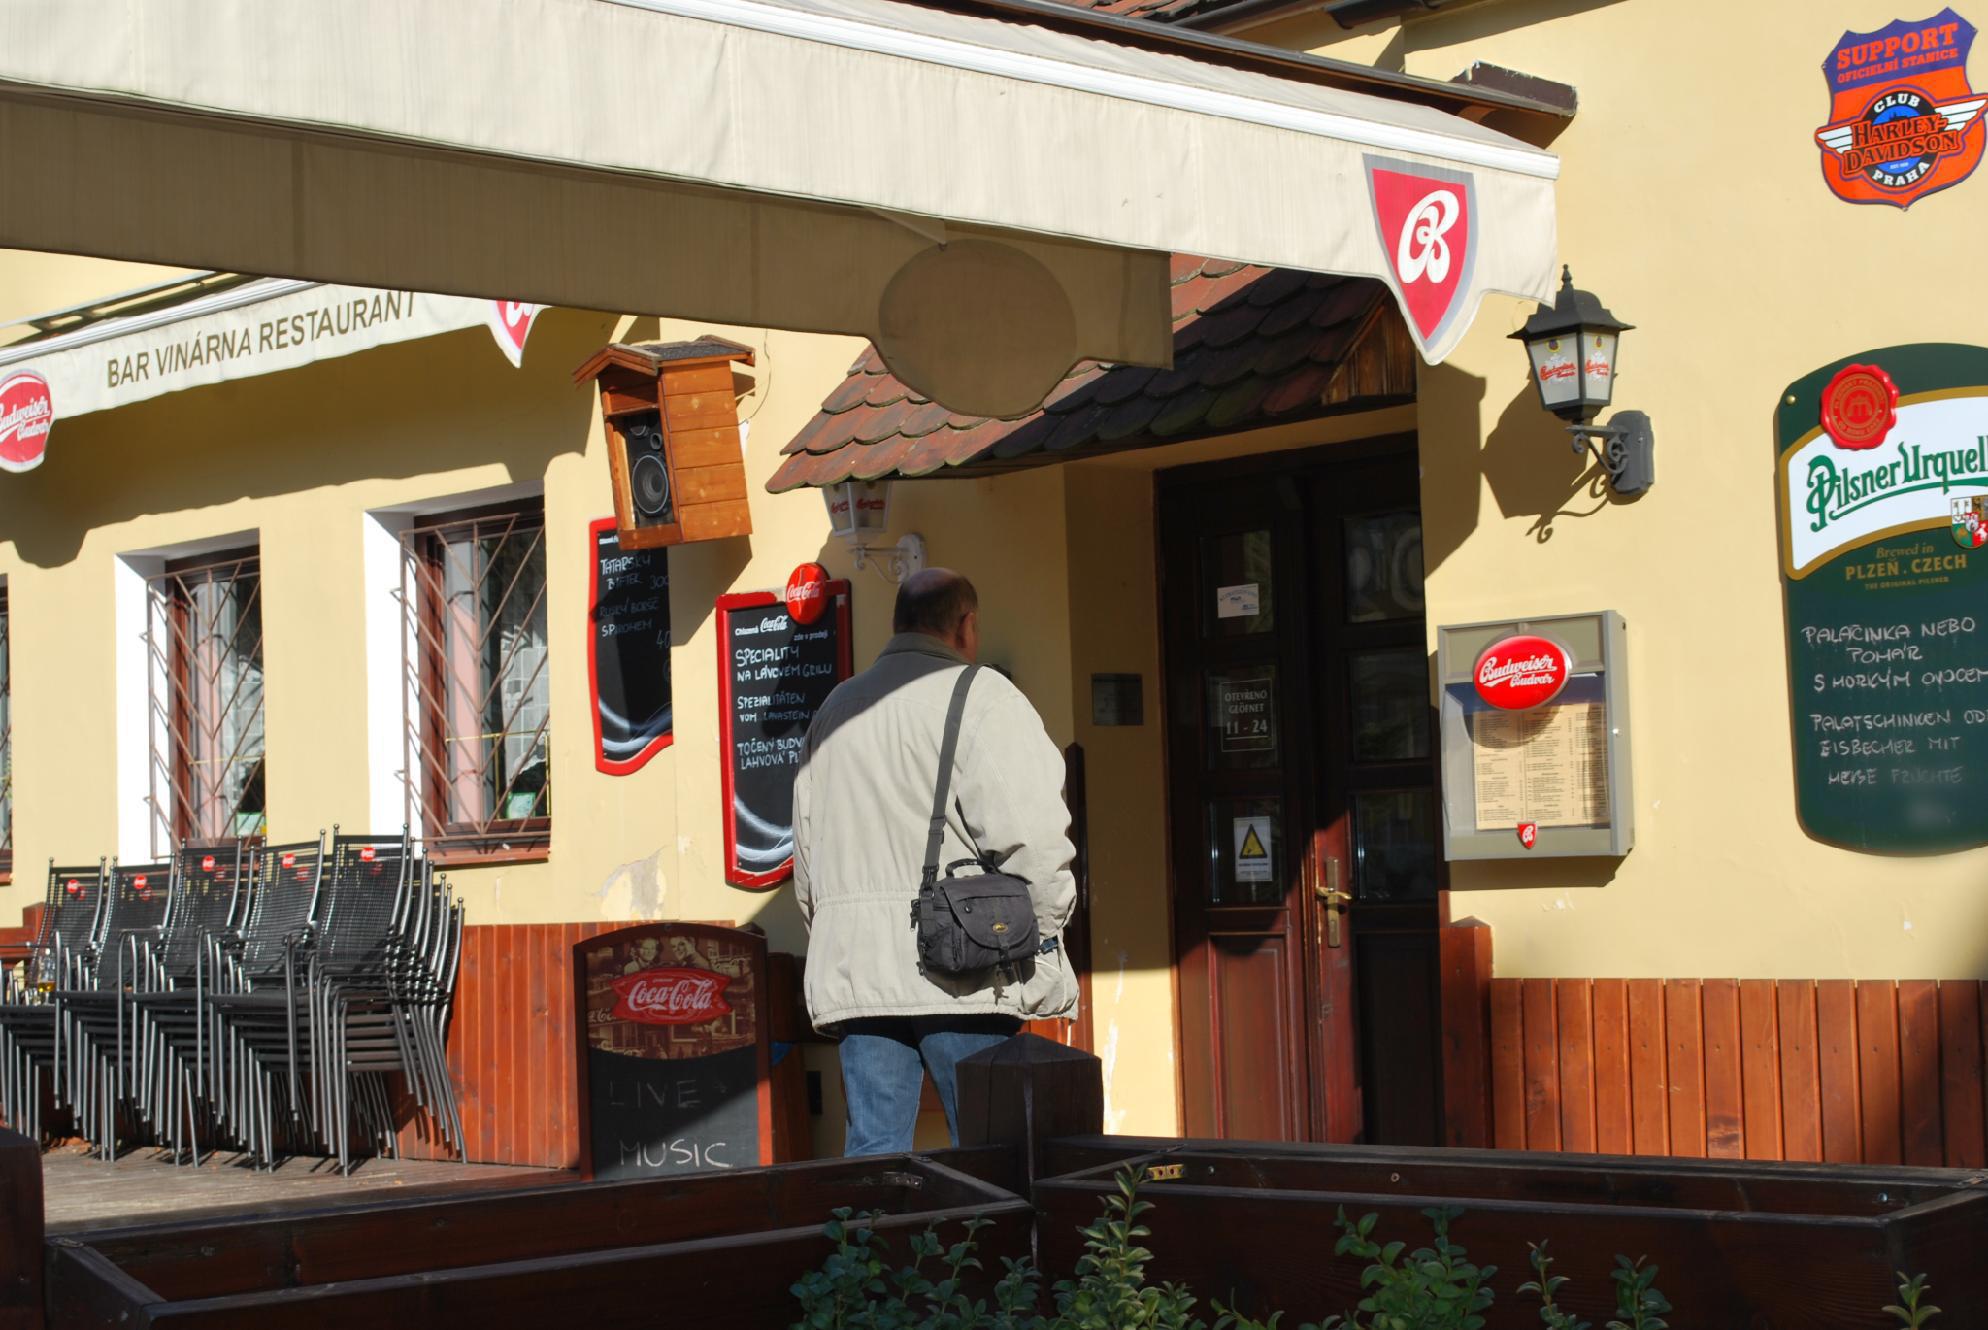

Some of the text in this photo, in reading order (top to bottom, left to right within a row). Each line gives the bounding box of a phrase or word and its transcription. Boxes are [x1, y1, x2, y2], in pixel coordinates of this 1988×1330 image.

[1836, 22, 1959, 70] SUPPORT
[1901, 48, 1959, 70] STANICE
[1873, 93, 1921, 114] CLUB
[1843, 131, 1958, 174] DAVIDSON
[1871, 162, 1930, 187] PRAHA
[107, 292, 414, 388] BAR VINÁRNA RESTAURANT
[1805, 435, 1988, 532] Pilsner Urquel
[1921, 541, 1935, 555] in
[1911, 553, 1968, 574] CZECH
[1800, 617, 1976, 645] PALAČINKA NEBO
[735, 645, 801, 667] SPECIALITY
[1845, 644, 1924, 665] POHÁR
[737, 670, 751, 682] NA
[1479, 654, 1558, 687] Budweiser
[1510, 674, 1555, 688] Budvar
[1813, 673, 1825, 692] S
[739, 712, 757, 723] VOM
[1251, 719, 1268, 733] 24
[1809, 709, 1952, 732] PALATSCHINKEN
[1819, 736, 1961, 757] EISBECHER MIT
[627, 977, 714, 1015] Coca-Cola
[609, 1080, 700, 1109] LIVE
[619, 1138, 734, 1169] MUSIC
